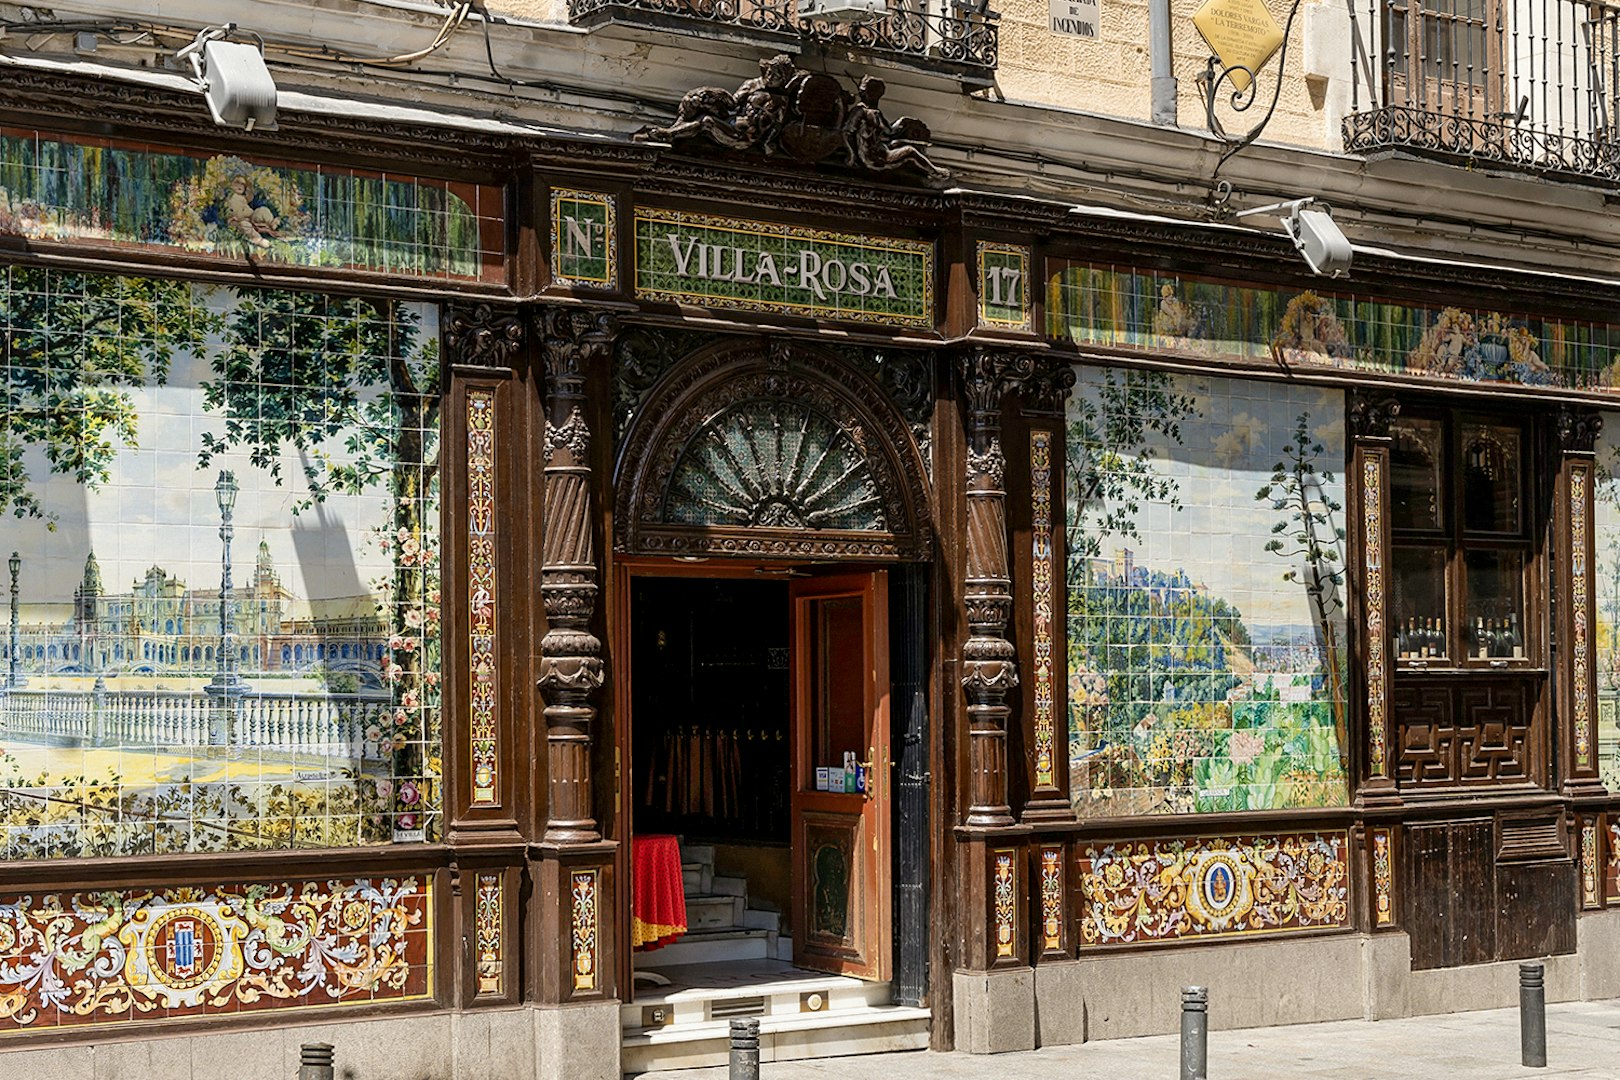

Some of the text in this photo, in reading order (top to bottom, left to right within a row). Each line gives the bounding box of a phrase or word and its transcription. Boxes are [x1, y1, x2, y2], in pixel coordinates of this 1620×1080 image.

[1069, 6, 1079, 15] DE
[1211, 8, 1242, 21] DOLORES
[1244, 14, 1269, 27] VARGAS
[1053, 17, 1094, 37] INCENDIOS
[986, 266, 1020, 307] 17
